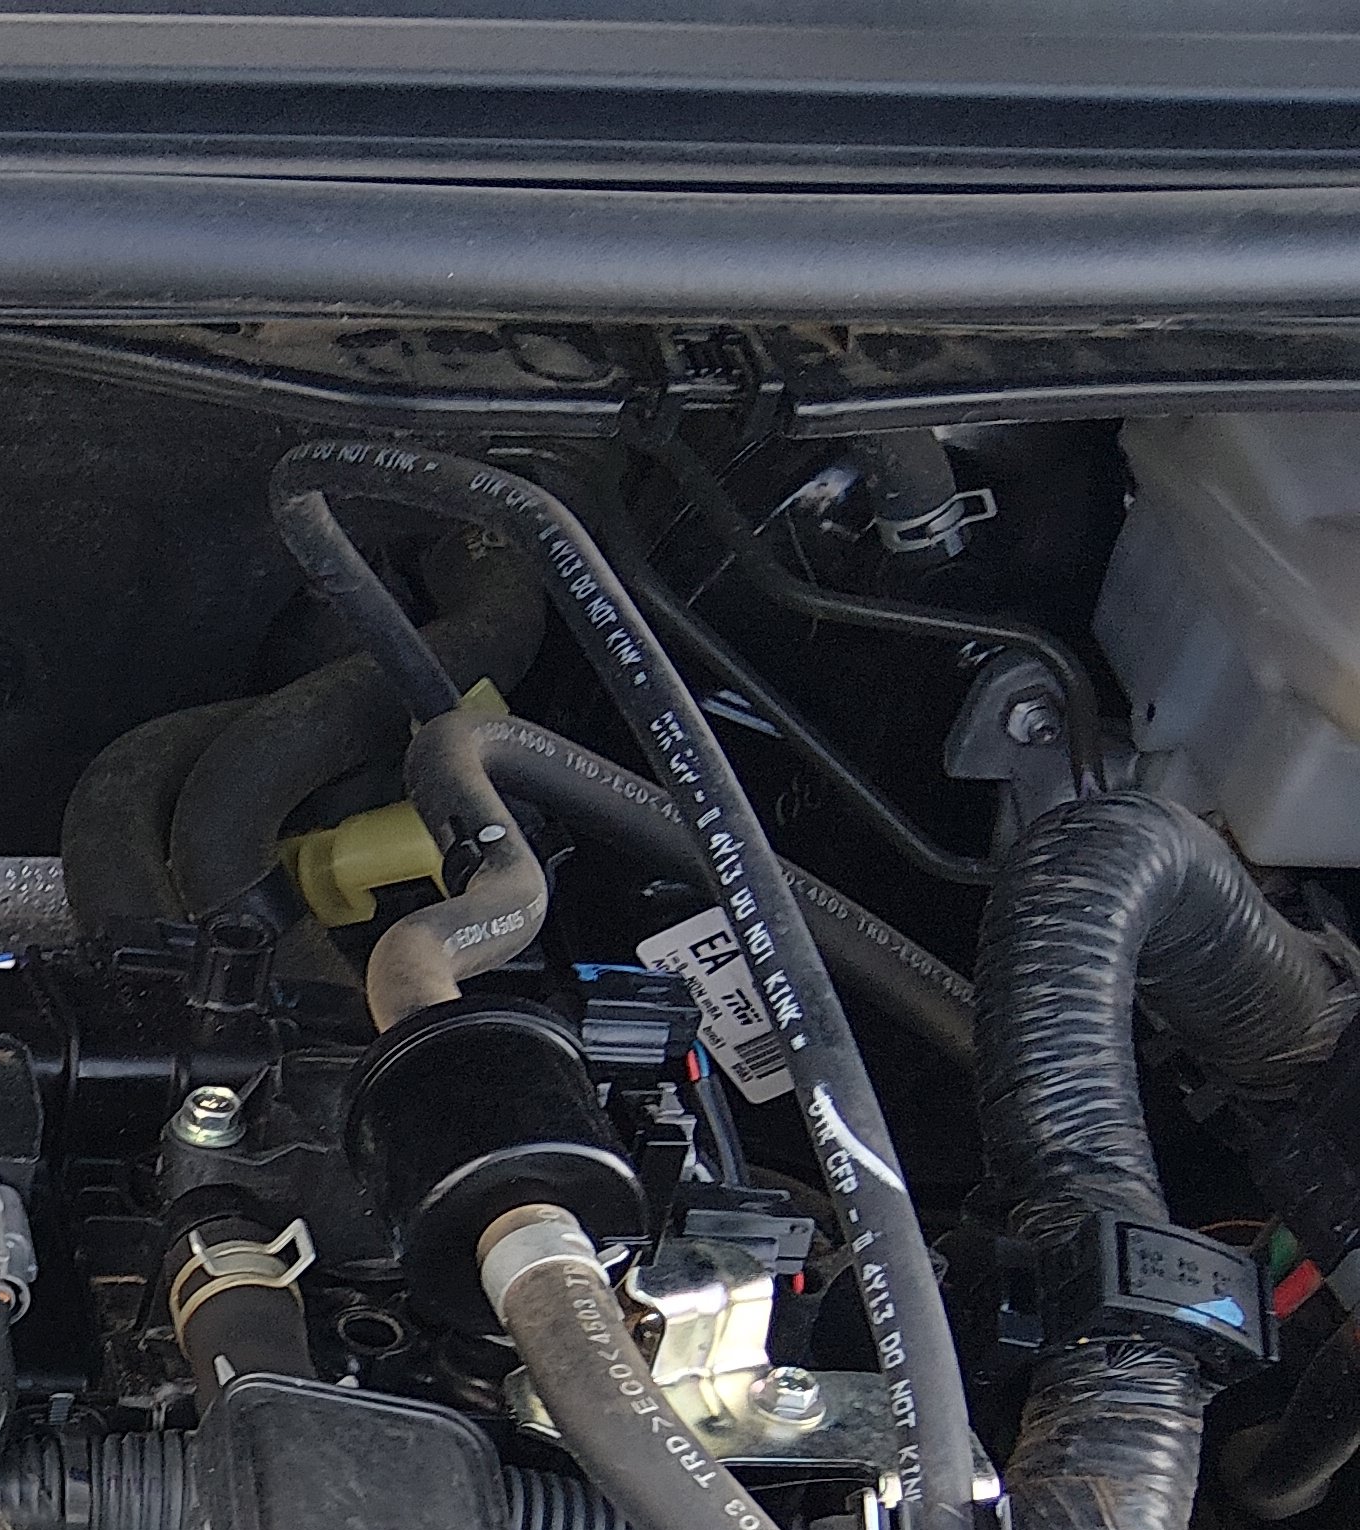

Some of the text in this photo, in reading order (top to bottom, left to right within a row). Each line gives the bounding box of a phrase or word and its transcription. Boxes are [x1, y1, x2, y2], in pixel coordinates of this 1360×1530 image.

[584, 596, 619, 630] NOT
[688, 930, 744, 976] EA
[721, 987, 764, 1027] TRW
[762, 968, 804, 1031] KINK
[825, 1149, 860, 1195] CFP
[862, 1261, 894, 1325] 4Y13
[879, 1330, 907, 1370] DO
[889, 1377, 918, 1430] NOT
